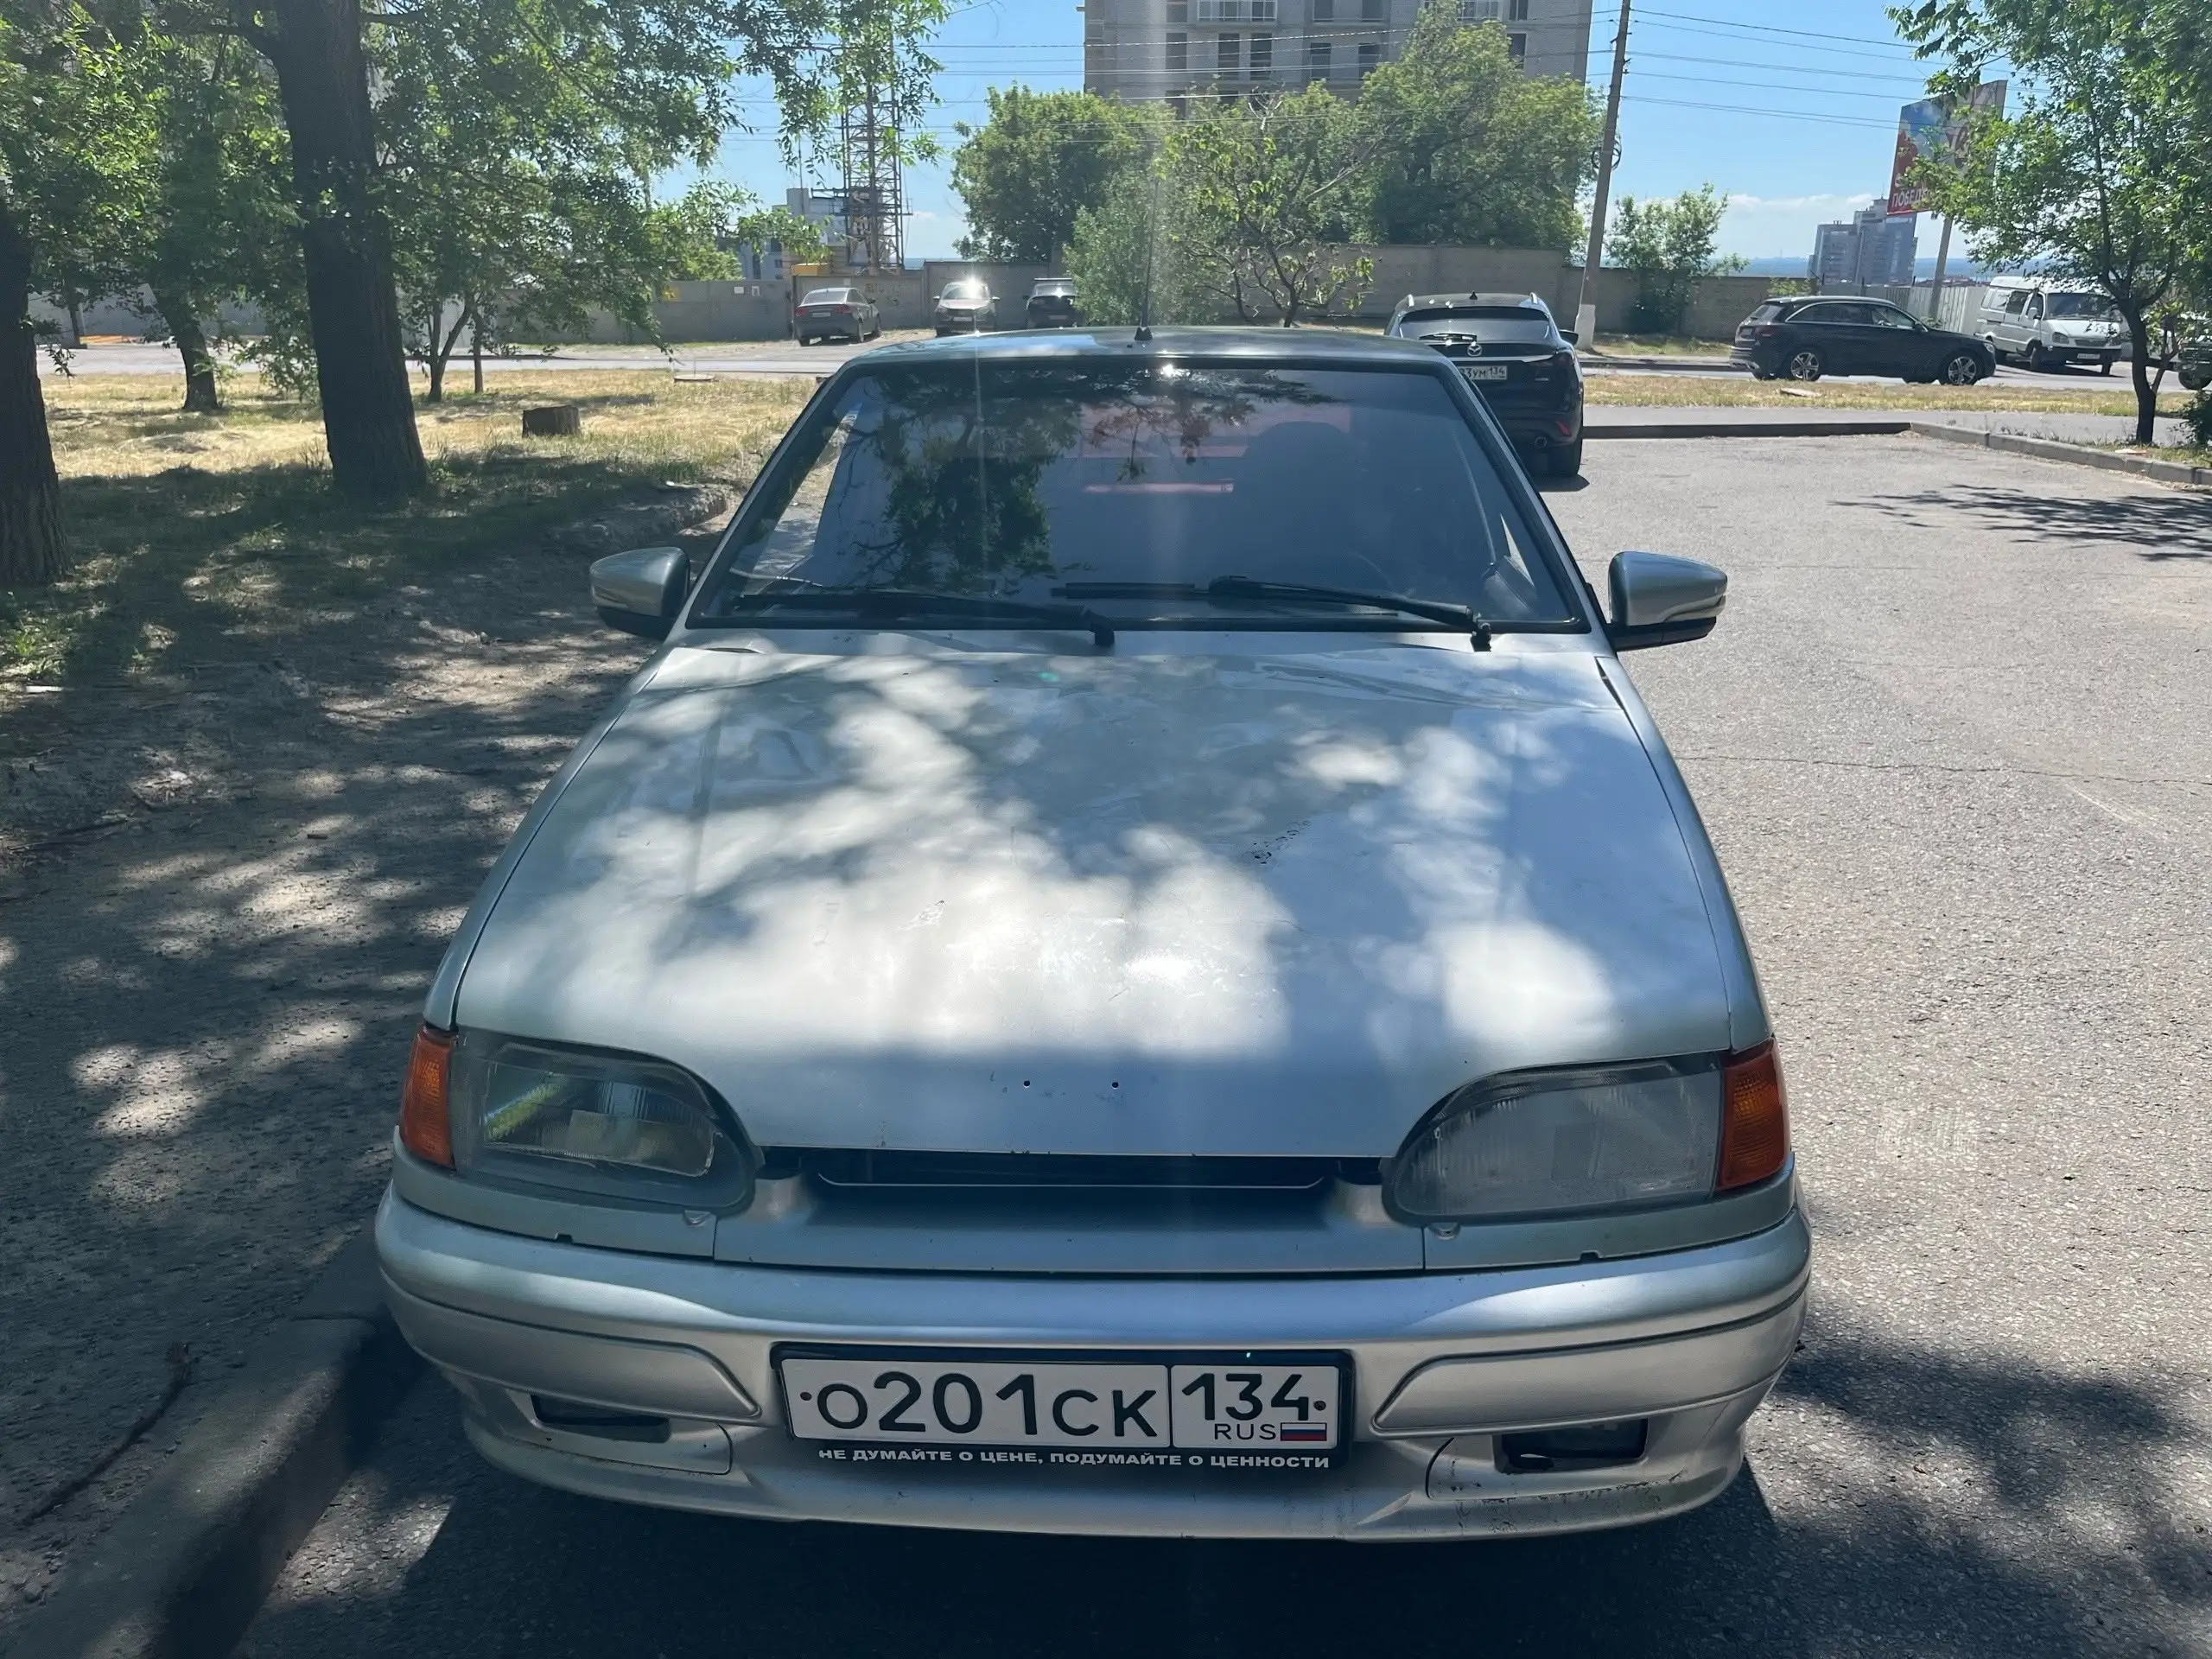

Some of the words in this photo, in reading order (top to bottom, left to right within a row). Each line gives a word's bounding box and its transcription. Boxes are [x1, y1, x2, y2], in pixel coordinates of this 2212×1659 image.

[1488, 366, 1505, 376] 134
[817, 1370, 1158, 1438] О201СК
[1181, 1372, 1309, 1421] 134
[1214, 1423, 1277, 1440] RUS
[818, 1449, 847, 1459] НЕ
[852, 1448, 953, 1461] ДУМАЙТЕ
[958, 1452, 974, 1461] О
[981, 1452, 1044, 1464] ЦЕНЕ,
[1050, 1452, 1182, 1465] ПОДУМАЙТЕ
[1188, 1455, 1204, 1465] О
[1211, 1455, 1330, 1468] ЦЕННОСТИ
